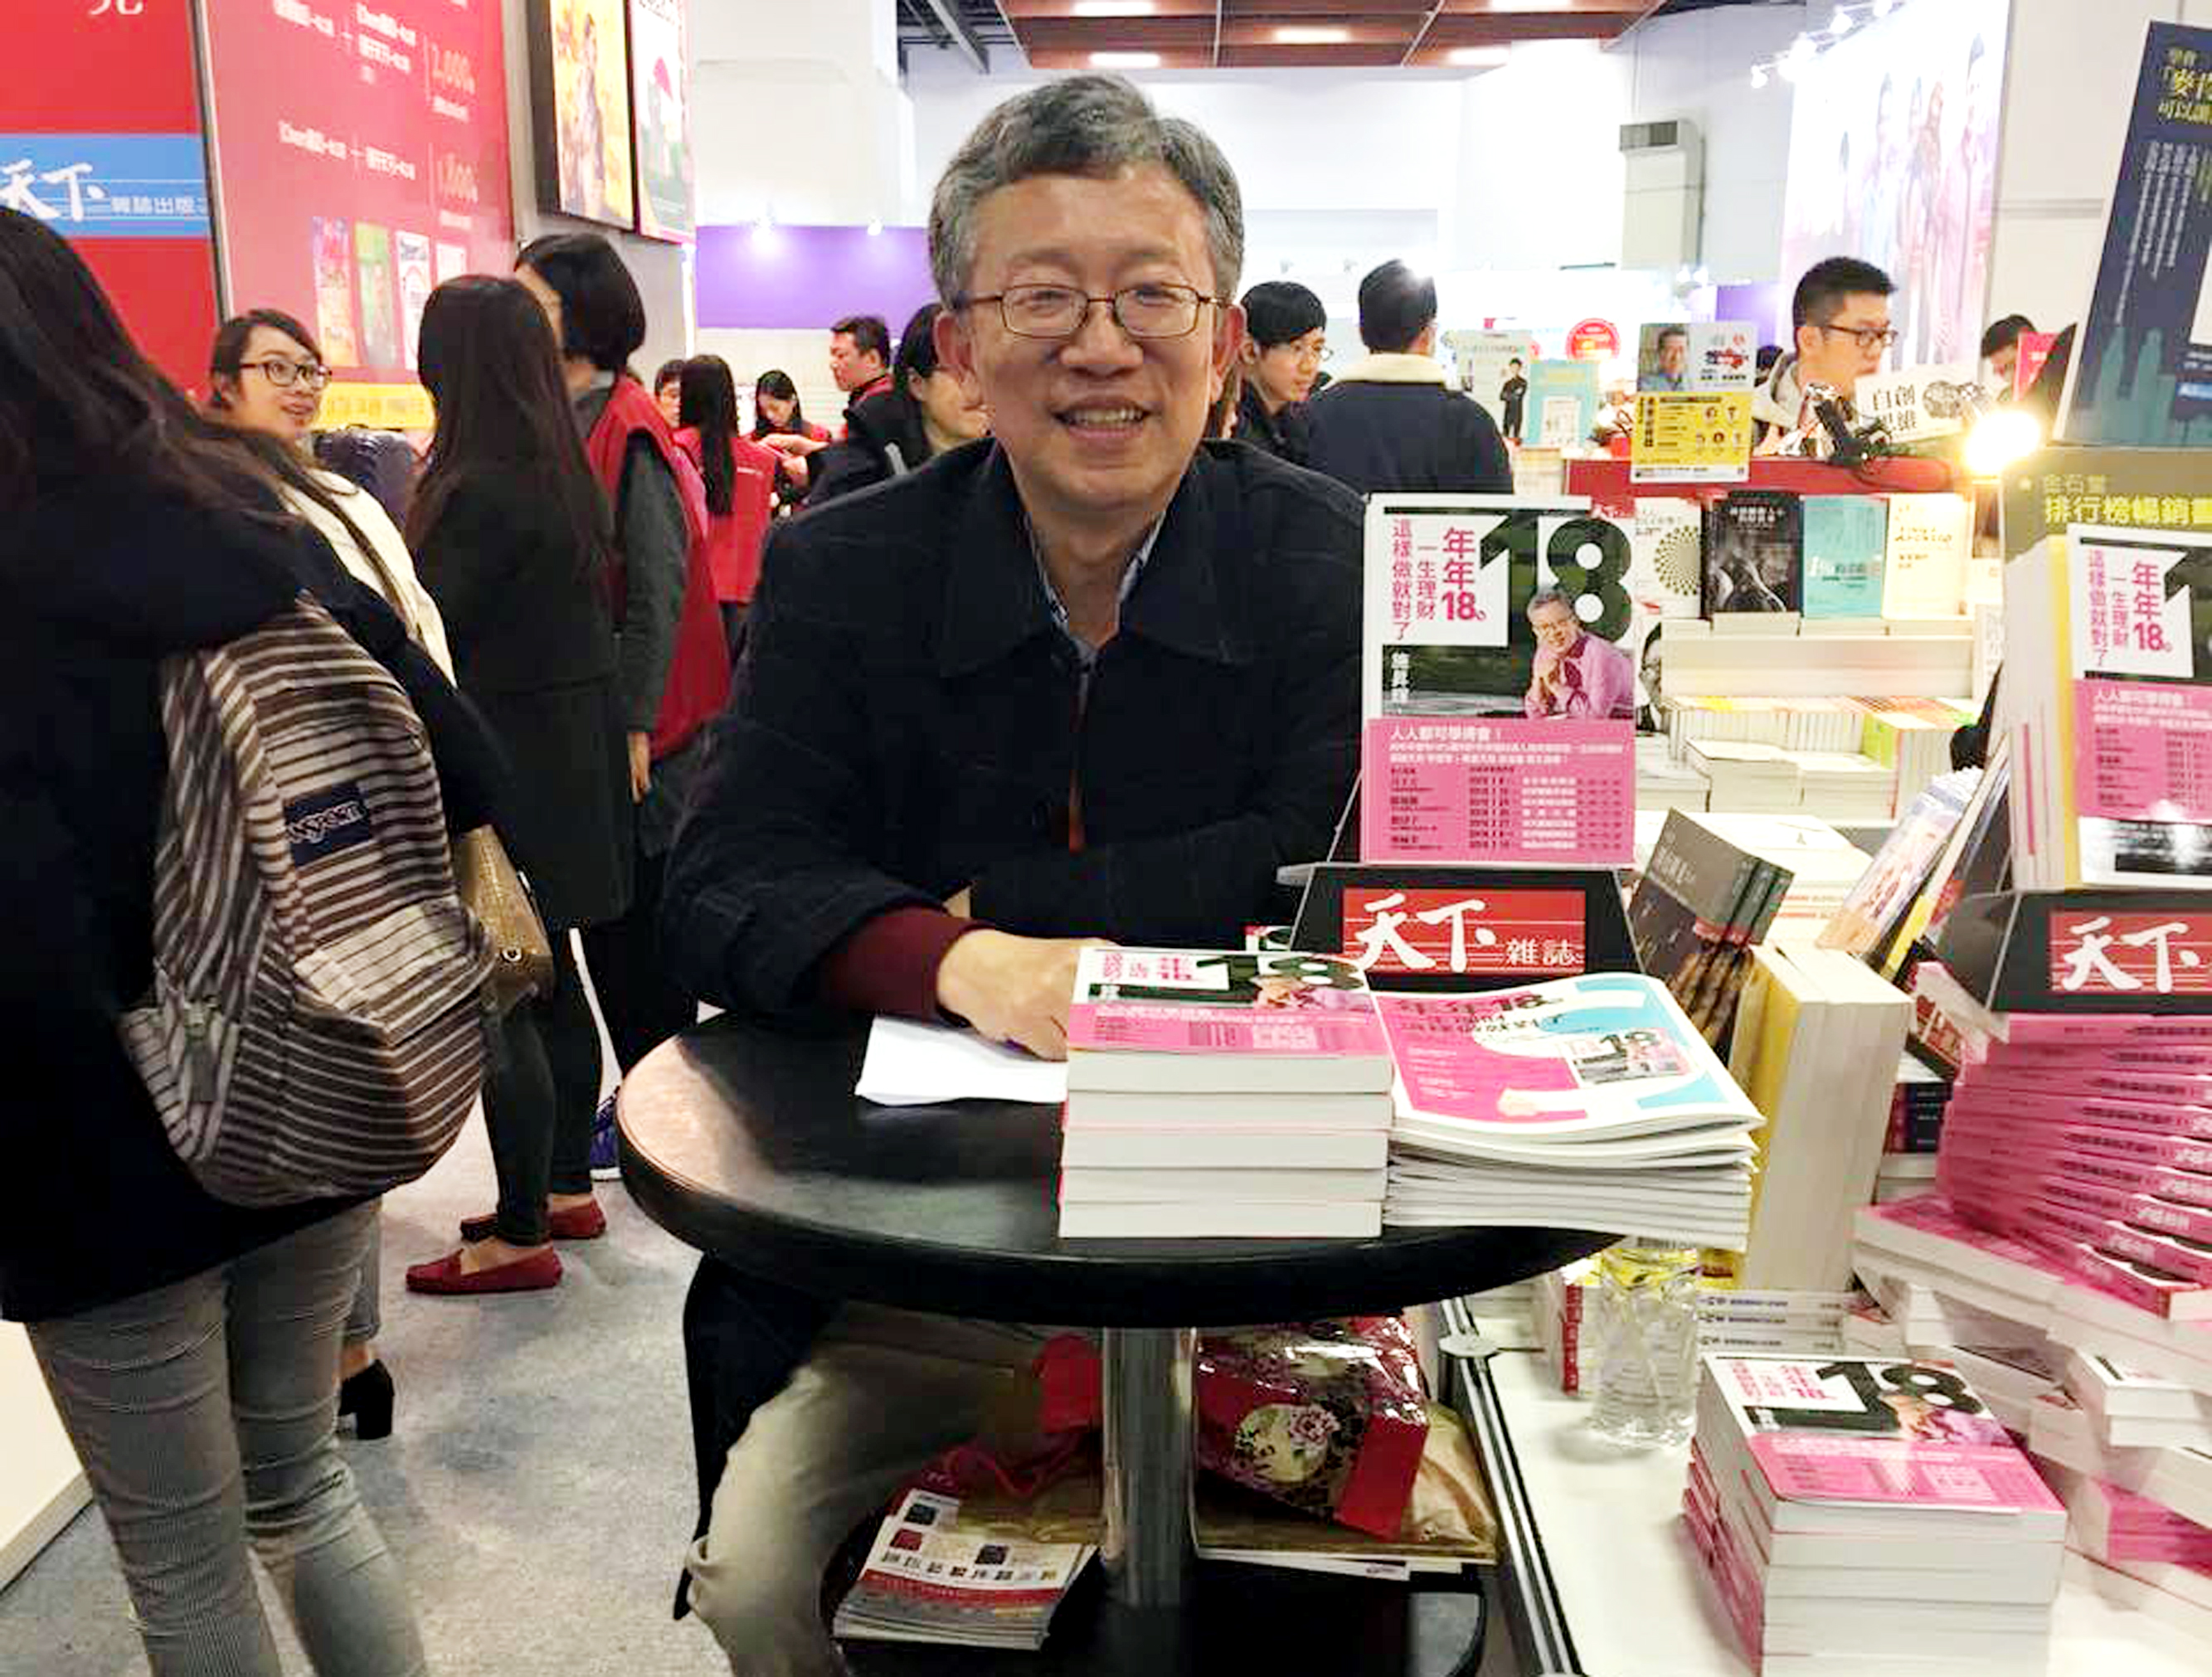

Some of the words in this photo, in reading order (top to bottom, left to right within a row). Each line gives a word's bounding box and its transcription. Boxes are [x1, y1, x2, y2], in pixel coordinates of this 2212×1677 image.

[1417, 545, 1437, 621] 一生理財
[1354, 892, 1497, 974] 天下
[1505, 939, 1577, 967] 雜誌
[2061, 915, 2200, 994] 天下
